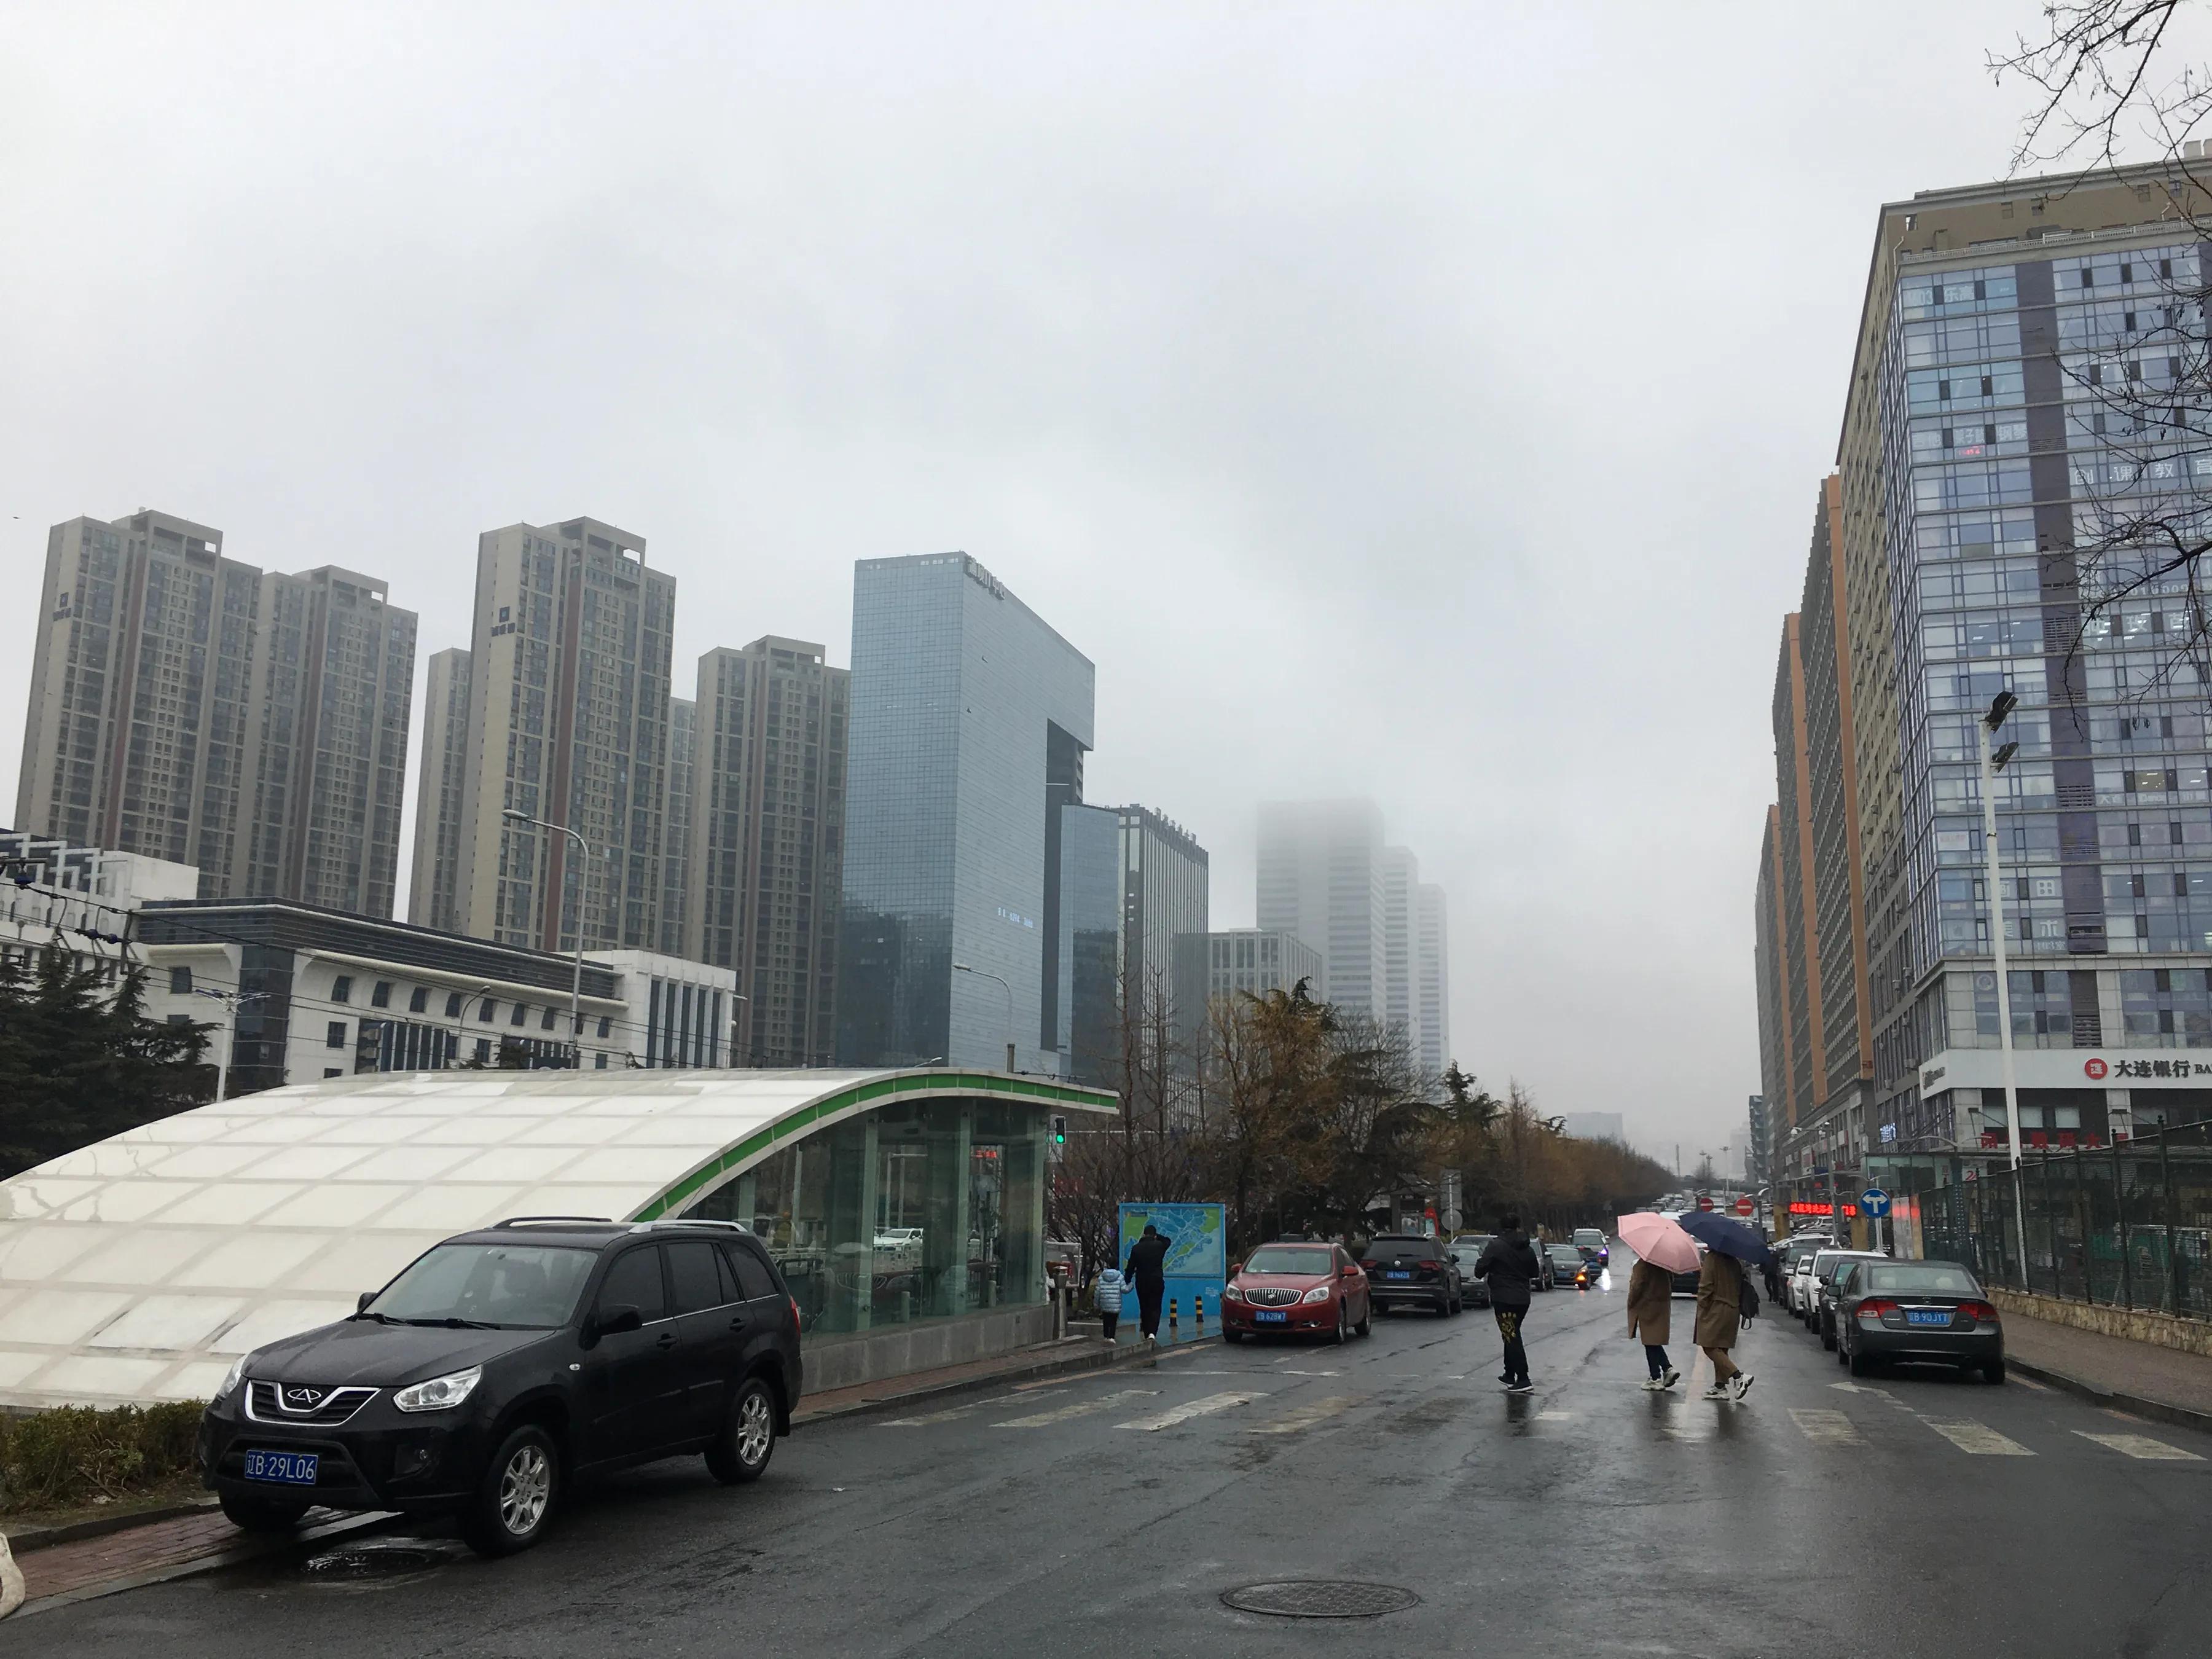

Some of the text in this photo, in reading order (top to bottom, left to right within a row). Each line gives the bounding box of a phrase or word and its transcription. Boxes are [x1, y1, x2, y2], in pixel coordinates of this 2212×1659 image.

[2114, 1060, 2191, 1078] 大连银行
[246, 1454, 315, 1479] 辽B·29L06
